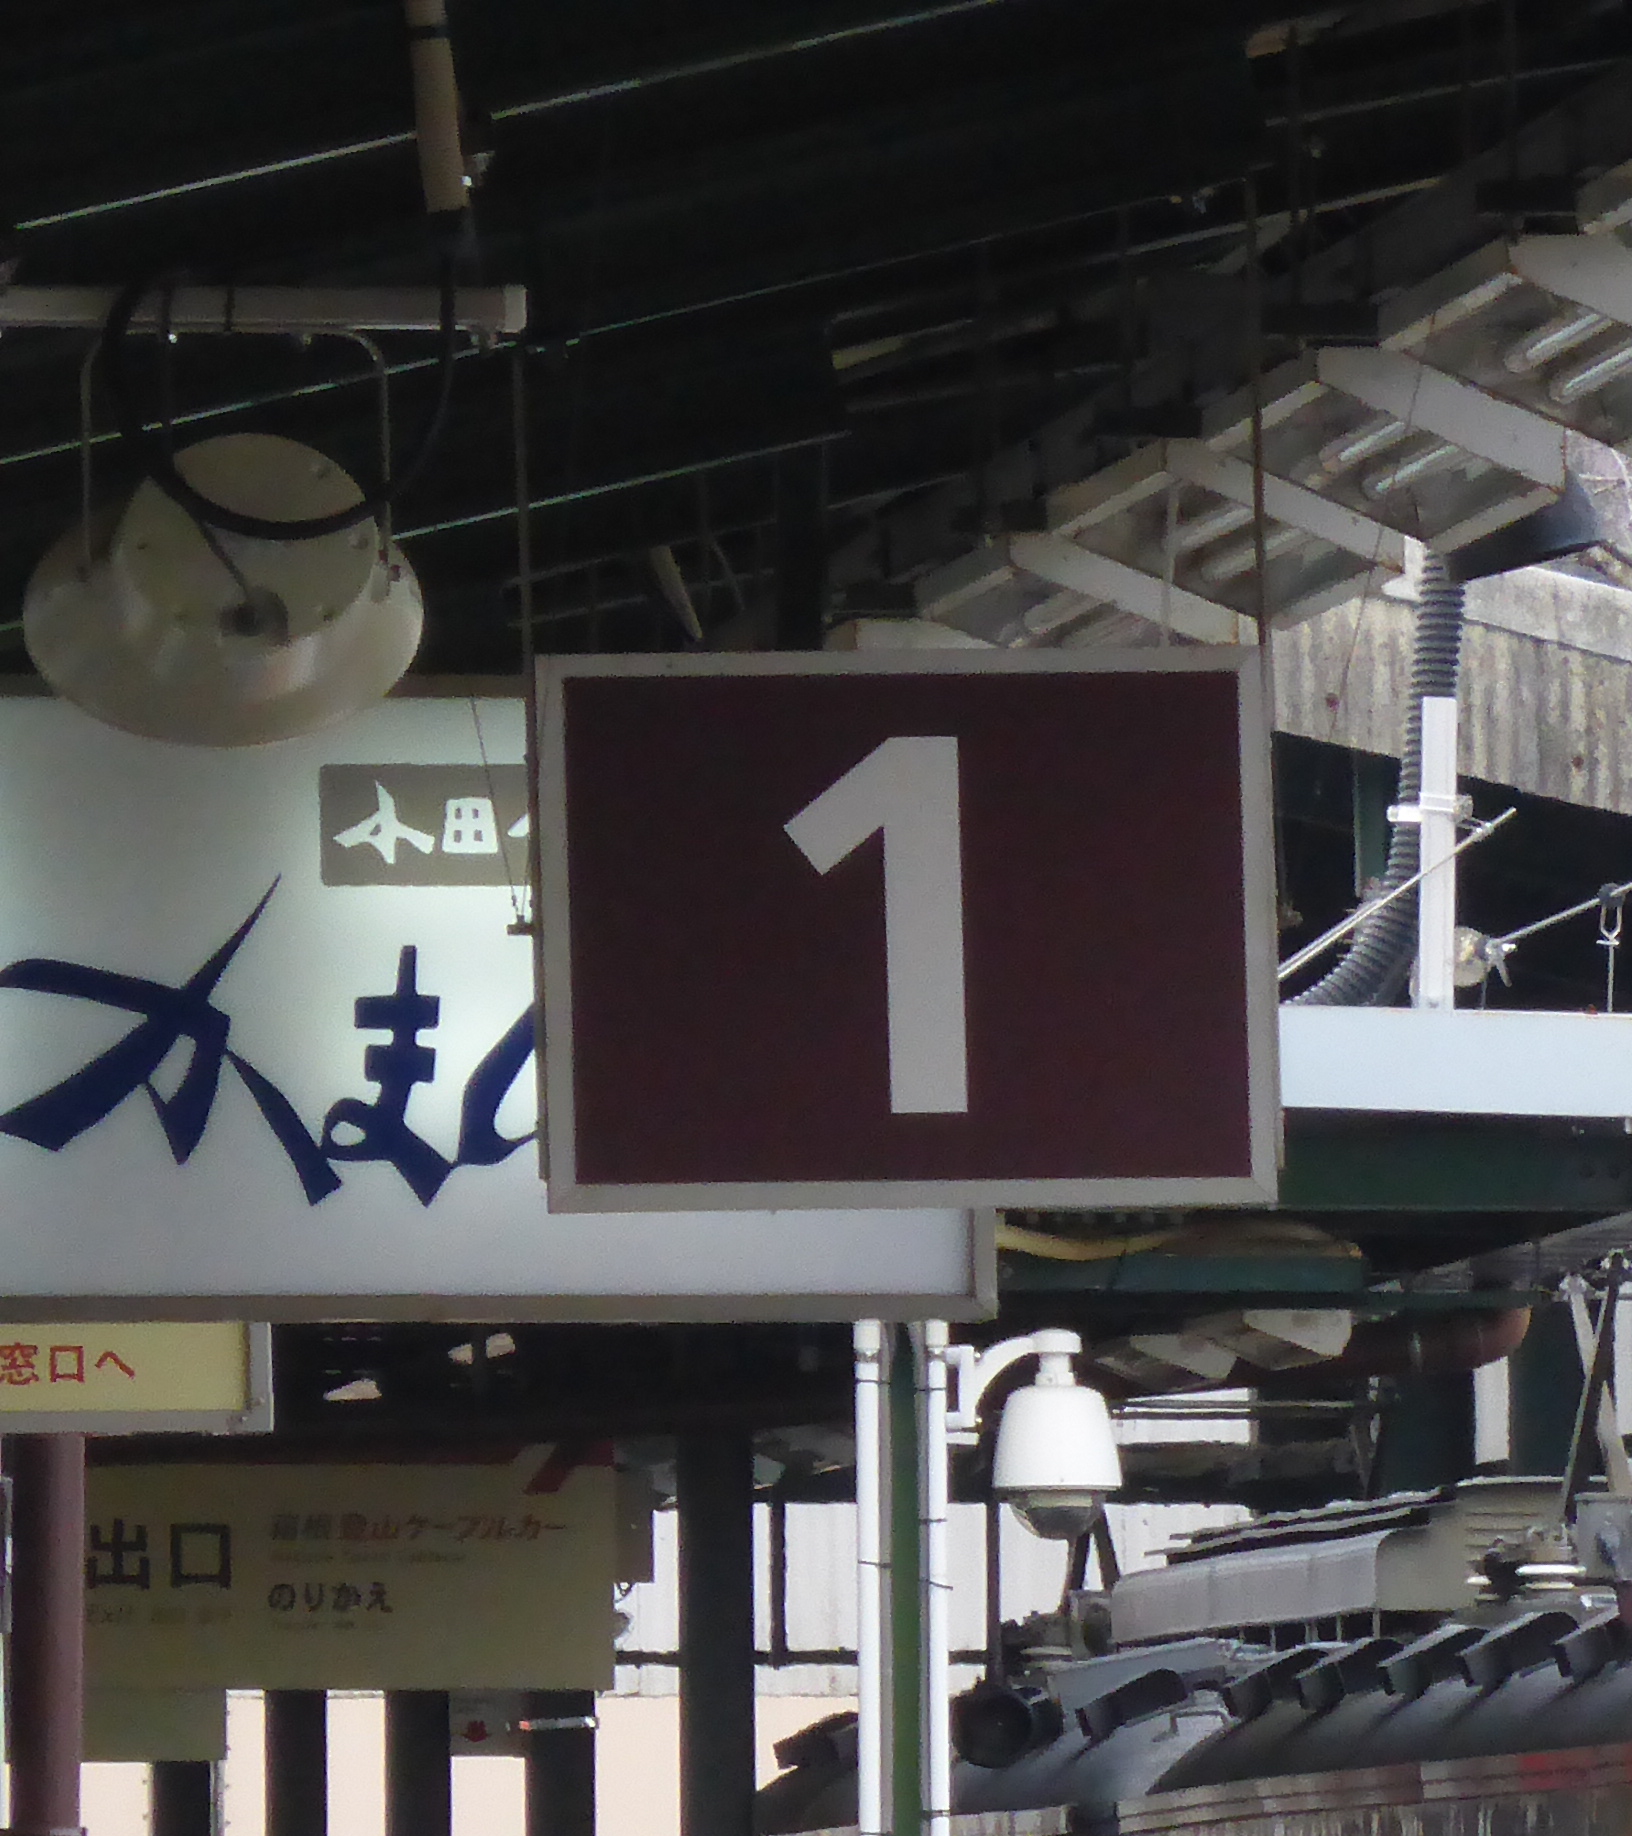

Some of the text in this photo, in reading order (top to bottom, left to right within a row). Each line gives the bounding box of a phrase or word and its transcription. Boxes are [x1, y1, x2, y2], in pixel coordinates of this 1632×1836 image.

[333, 780, 530, 865] 小田
[783, 736, 968, 1113] 1
[86, 1518, 232, 1591] 出口
[268, 1581, 394, 1613] のりかえ
